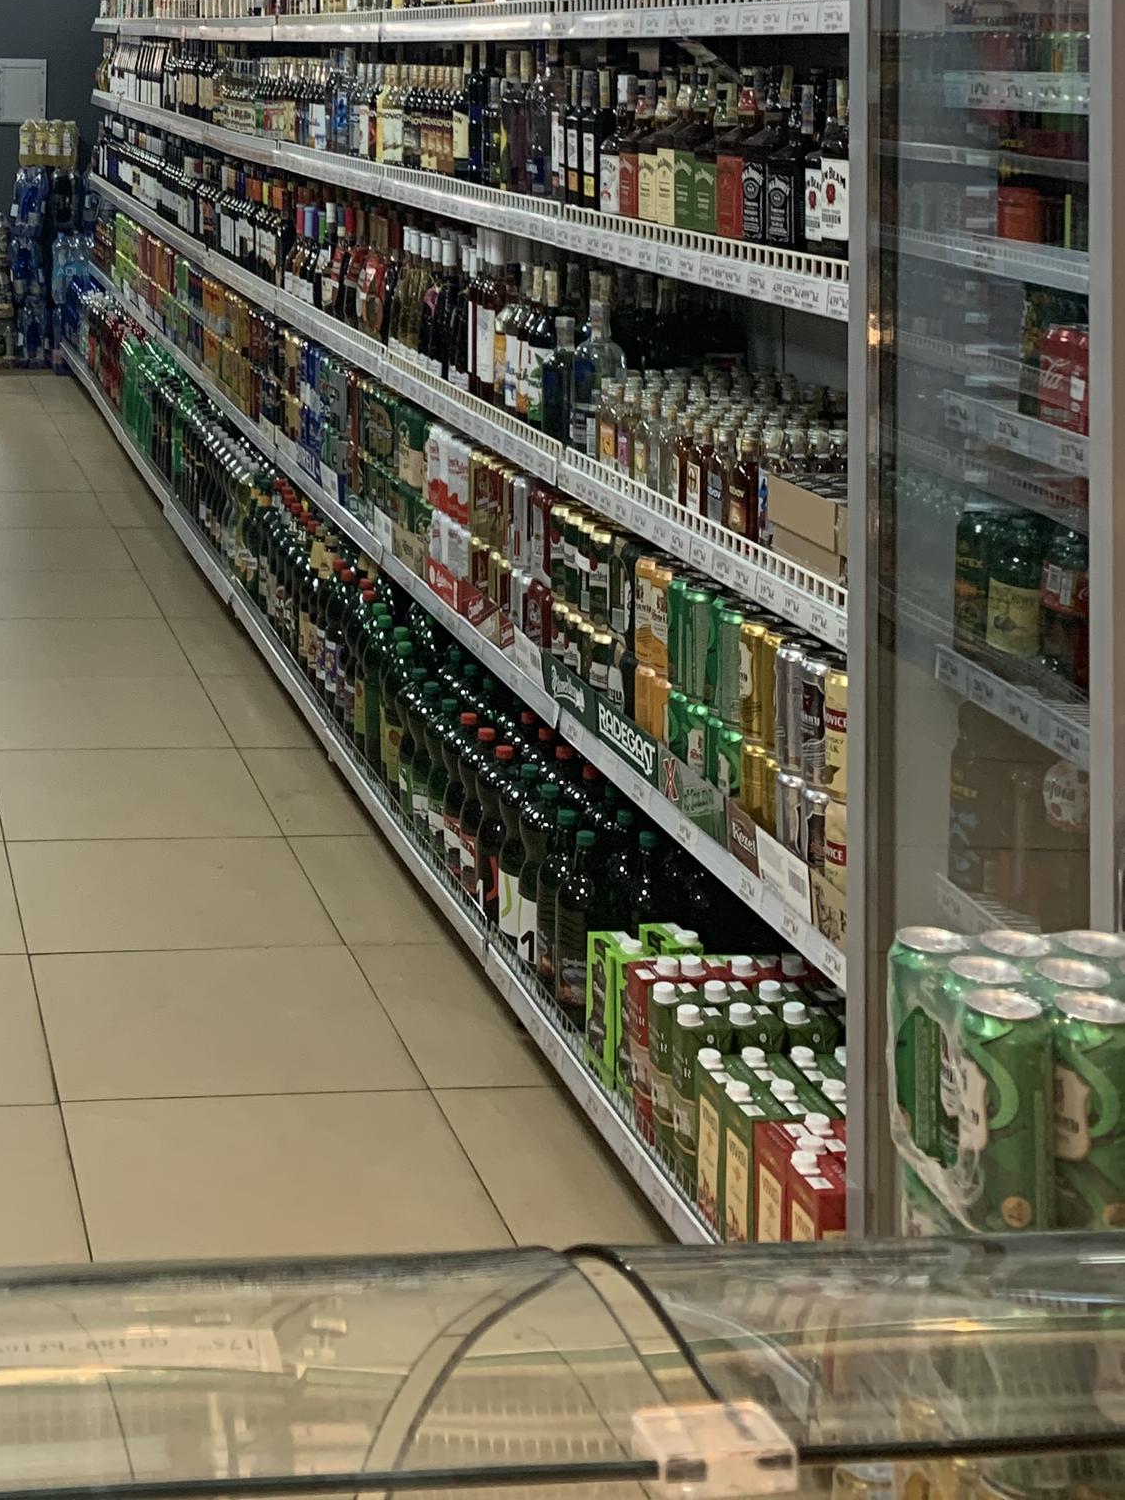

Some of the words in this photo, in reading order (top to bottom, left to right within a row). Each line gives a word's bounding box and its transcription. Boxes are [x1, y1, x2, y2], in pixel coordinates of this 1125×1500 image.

[825, 713, 847, 729] OVICE
[598, 702, 656, 776] RADEGAST
[731, 821, 756, 854] Kozel
